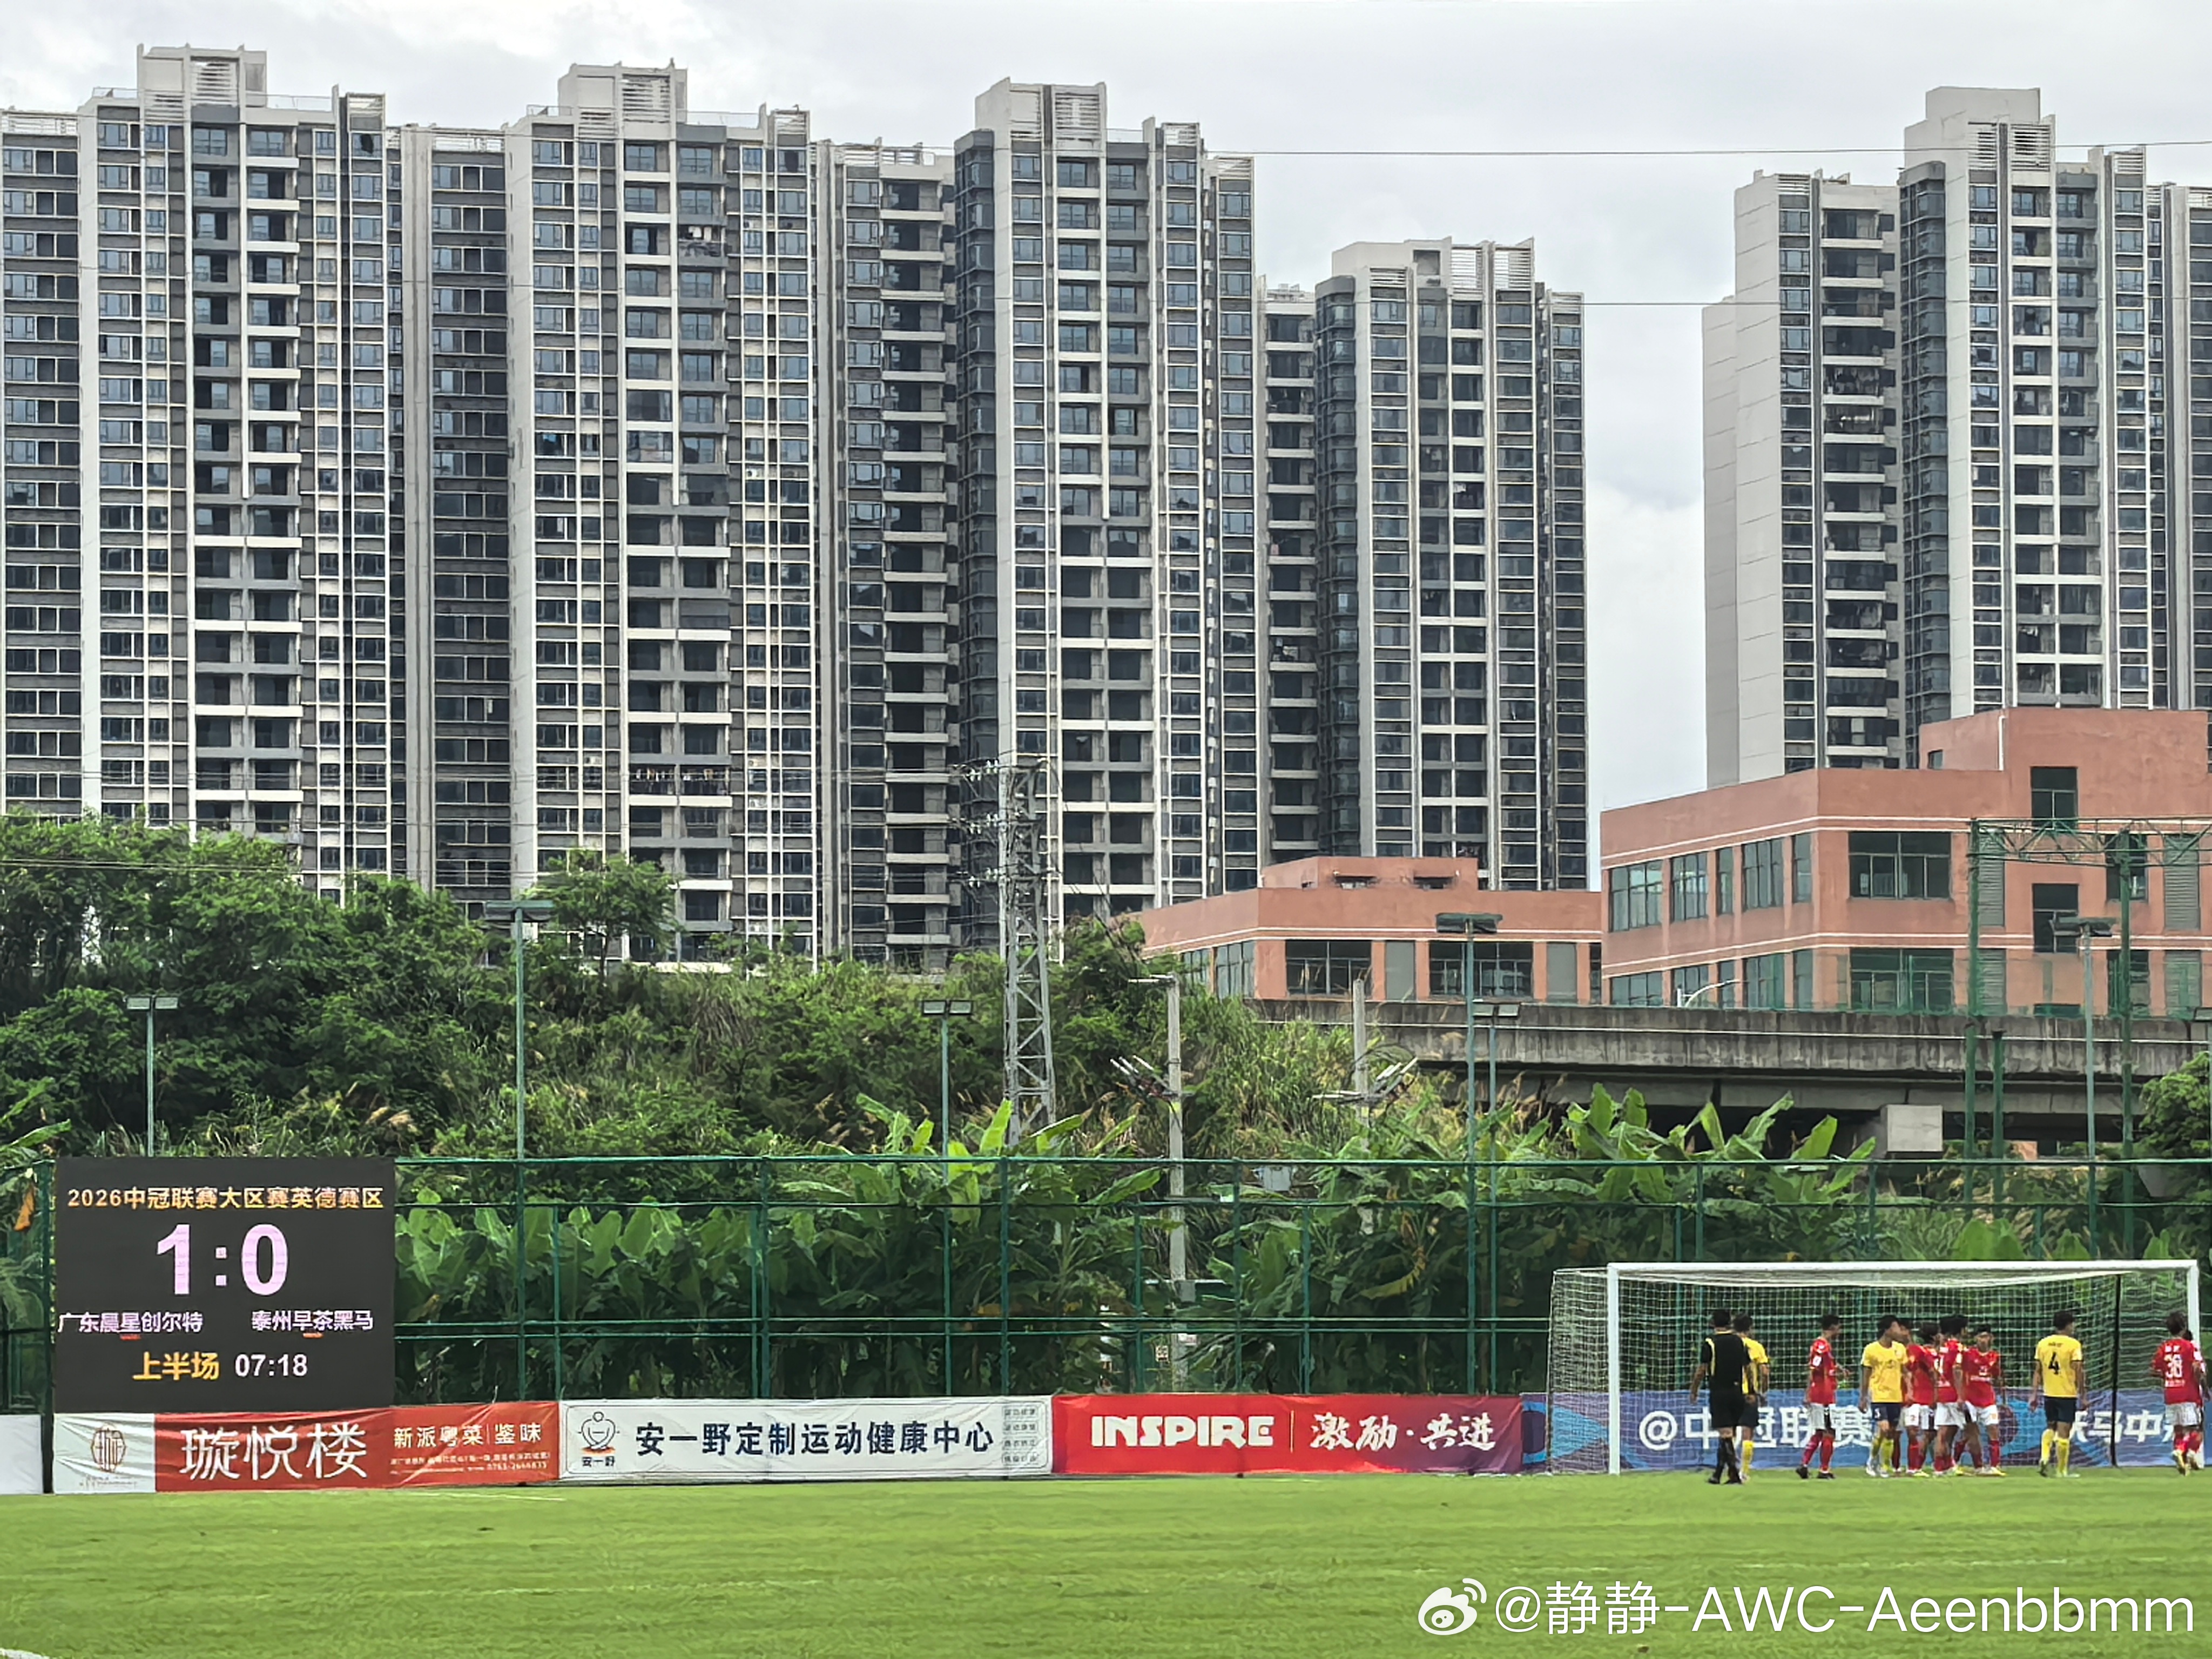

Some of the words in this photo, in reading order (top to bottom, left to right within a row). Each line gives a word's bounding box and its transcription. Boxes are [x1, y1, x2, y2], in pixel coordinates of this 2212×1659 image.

[68, 1186, 384, 1210] 2026中冠联赛大区赛英德赛区
[157, 1224, 288, 1296] 1:0
[57, 1312, 203, 1333] 广东晨星创尔特
[251, 1310, 373, 1331] 泰州早茶黑马
[133, 1351, 220, 1381] 上半场
[234, 1354, 308, 1377] 07:18
[2048, 1352, 2060, 1375] 4
[394, 1424, 484, 1448] 新派粤菜
[635, 1420, 994, 1457] 安一野定制运动健康中心
[1091, 1415, 1274, 1449] INSPIRE
[1309, 1412, 1497, 1452] 激励·共进
[179, 1421, 368, 1480] 璇悦楼
